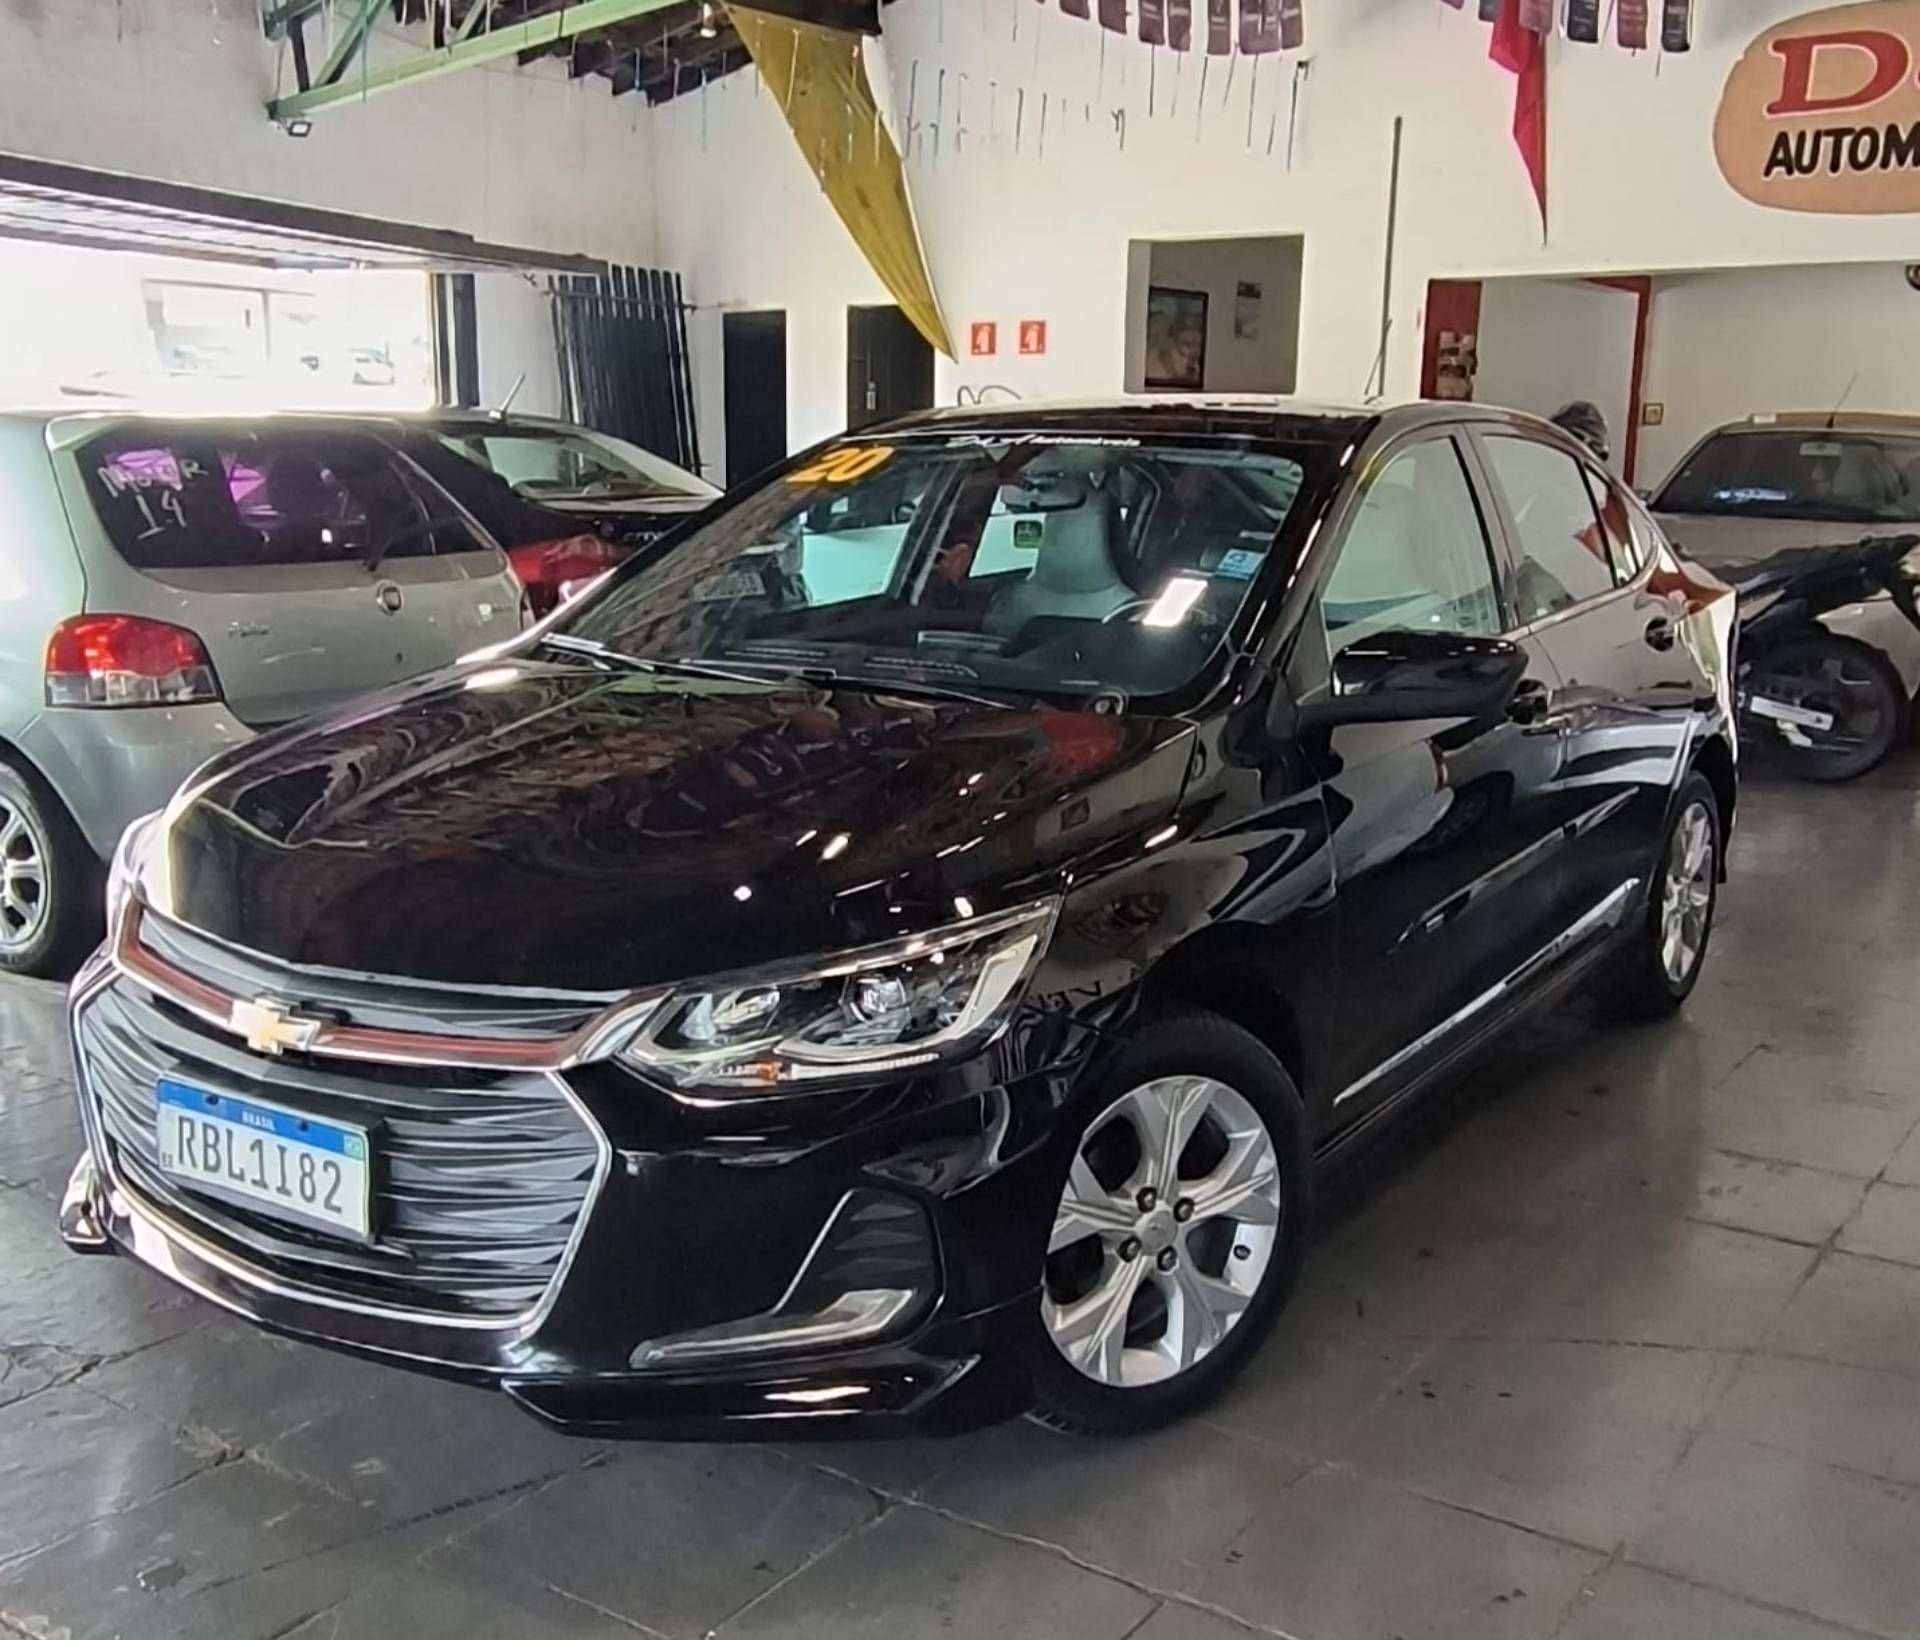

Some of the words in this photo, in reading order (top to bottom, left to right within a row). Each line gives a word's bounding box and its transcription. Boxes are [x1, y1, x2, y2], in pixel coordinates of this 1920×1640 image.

[1765, 29, 1920, 116] D
[785, 446, 895, 483] 20
[177, 1114, 342, 1215] RBL1I82
